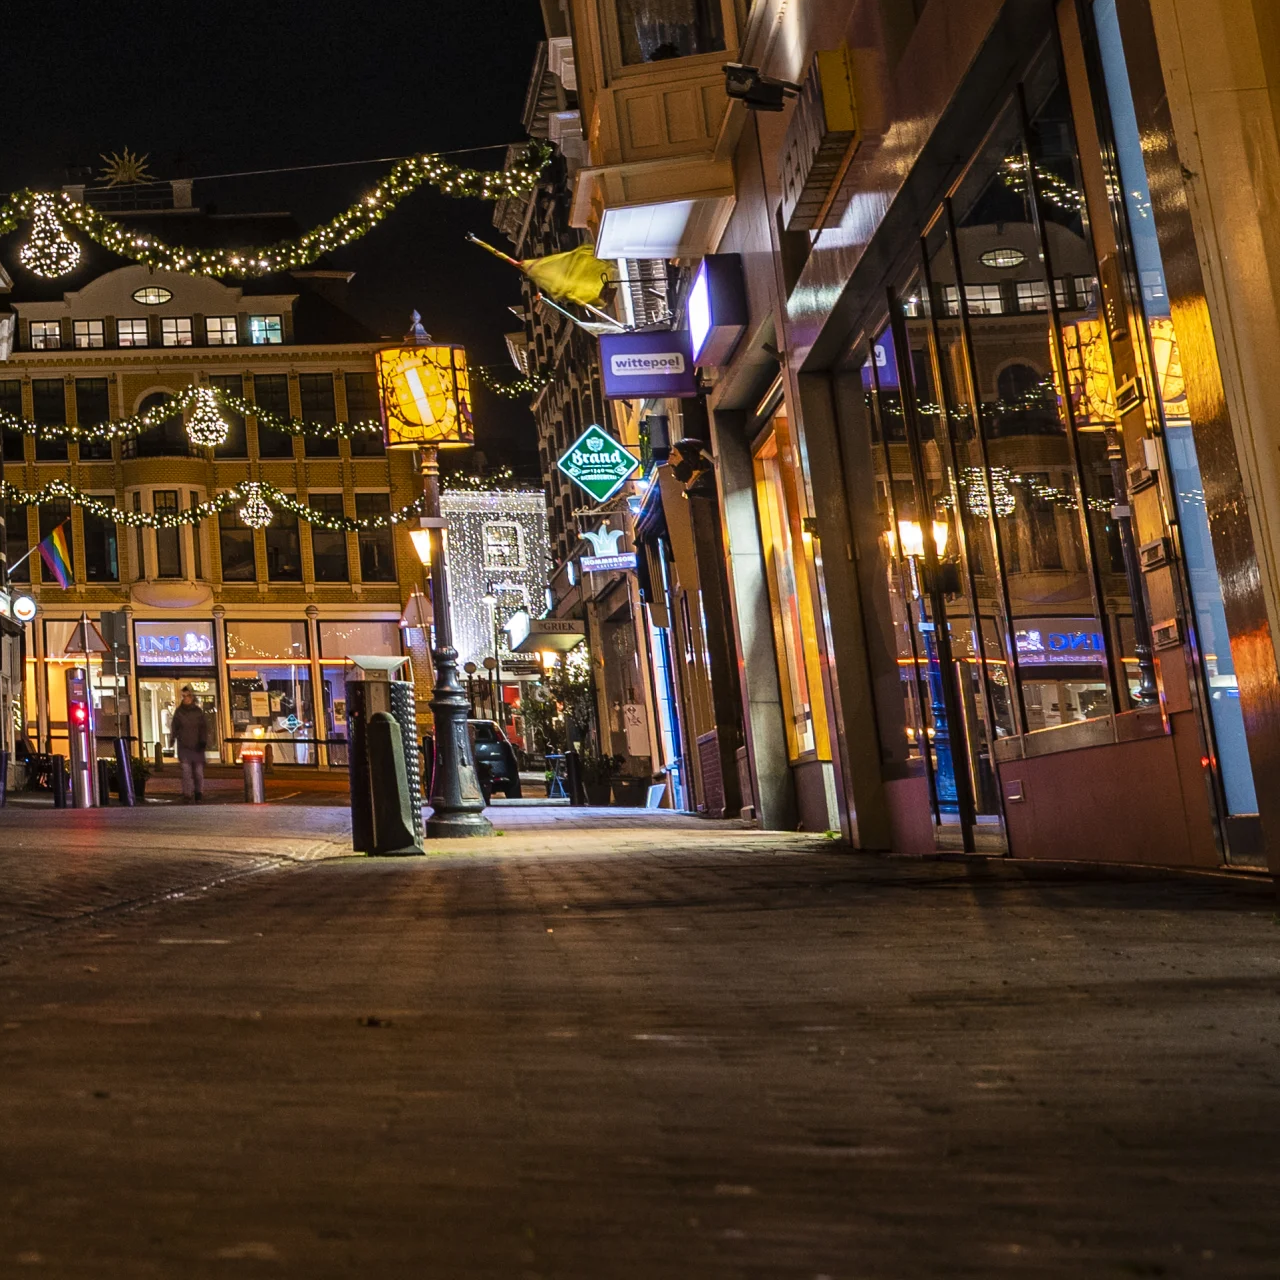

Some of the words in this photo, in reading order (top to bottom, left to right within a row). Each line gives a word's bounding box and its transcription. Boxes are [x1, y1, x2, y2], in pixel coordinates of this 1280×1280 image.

[615, 355, 680, 369] wittepoel
[572, 449, 622, 466] Brand
[543, 622, 576, 631] GRIEK
[138, 635, 180, 652] ING
